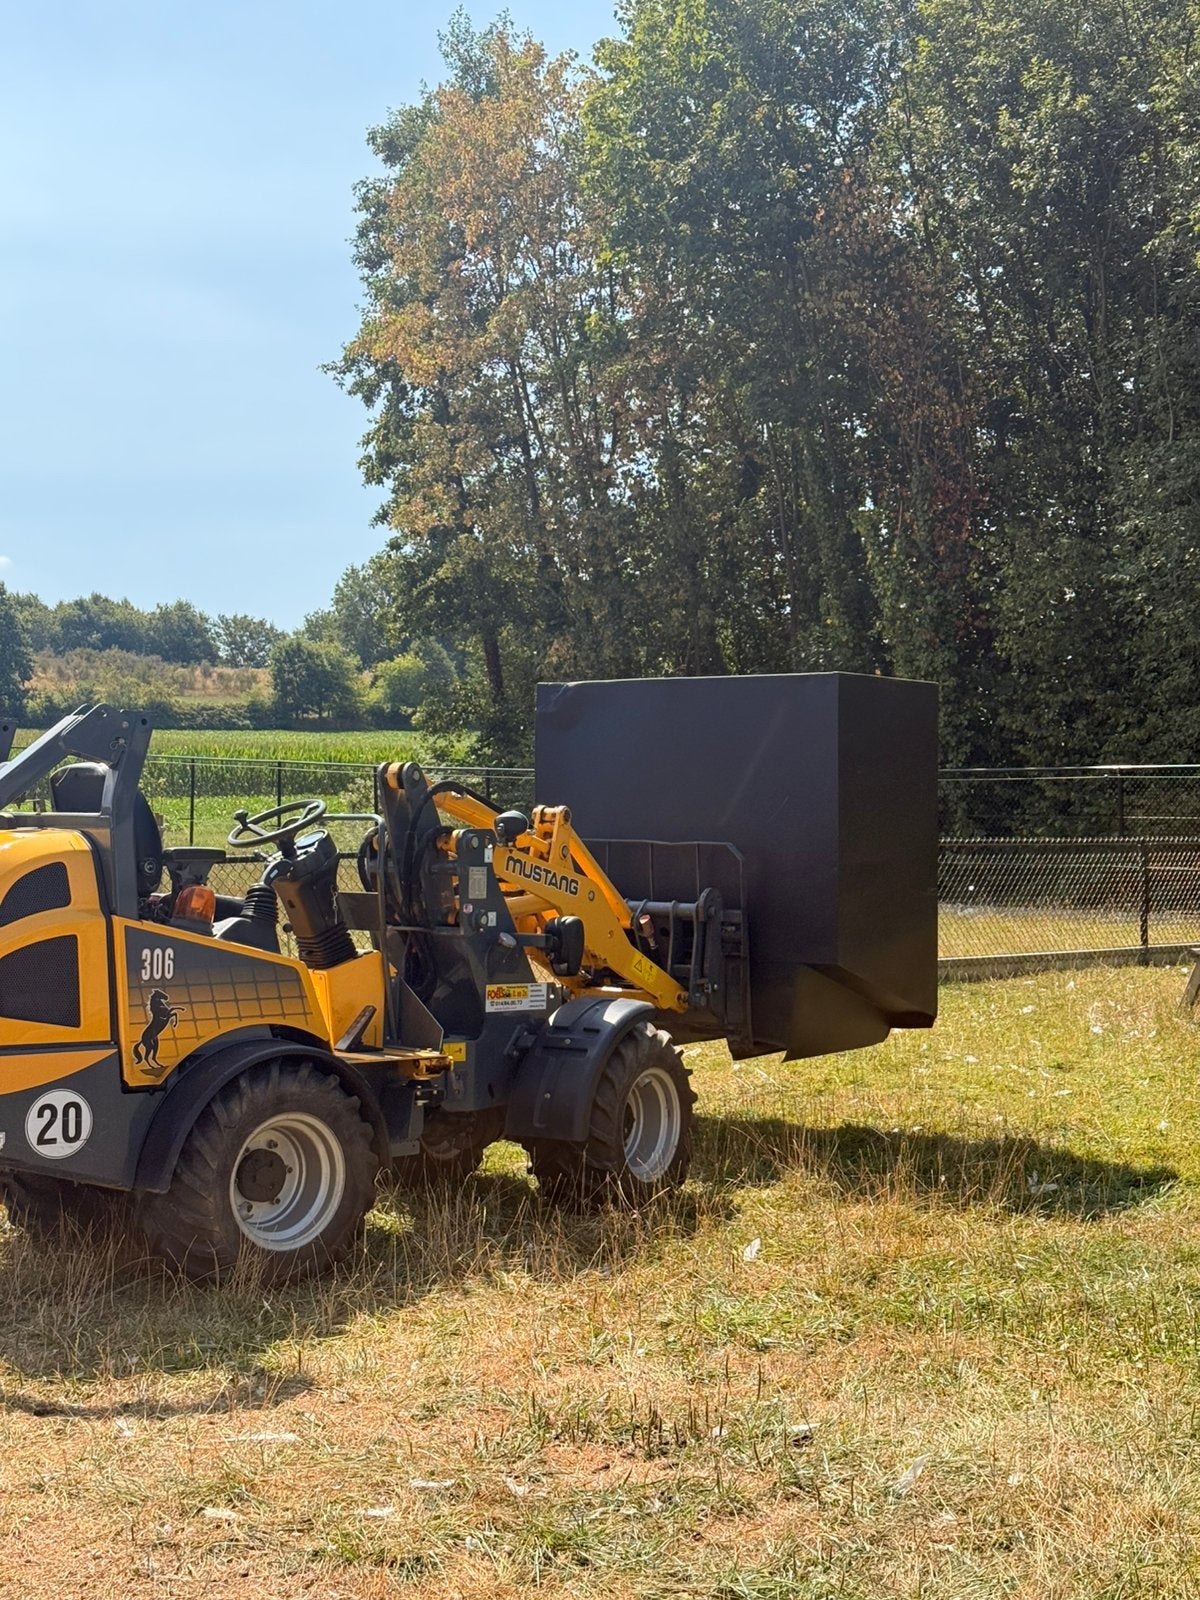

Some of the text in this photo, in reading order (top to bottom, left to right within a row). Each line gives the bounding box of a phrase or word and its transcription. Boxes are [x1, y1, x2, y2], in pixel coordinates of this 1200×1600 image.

[505, 855, 579, 896] MUSTANG
[141, 947, 174, 981] 306
[36, 1101, 82, 1146] 20
